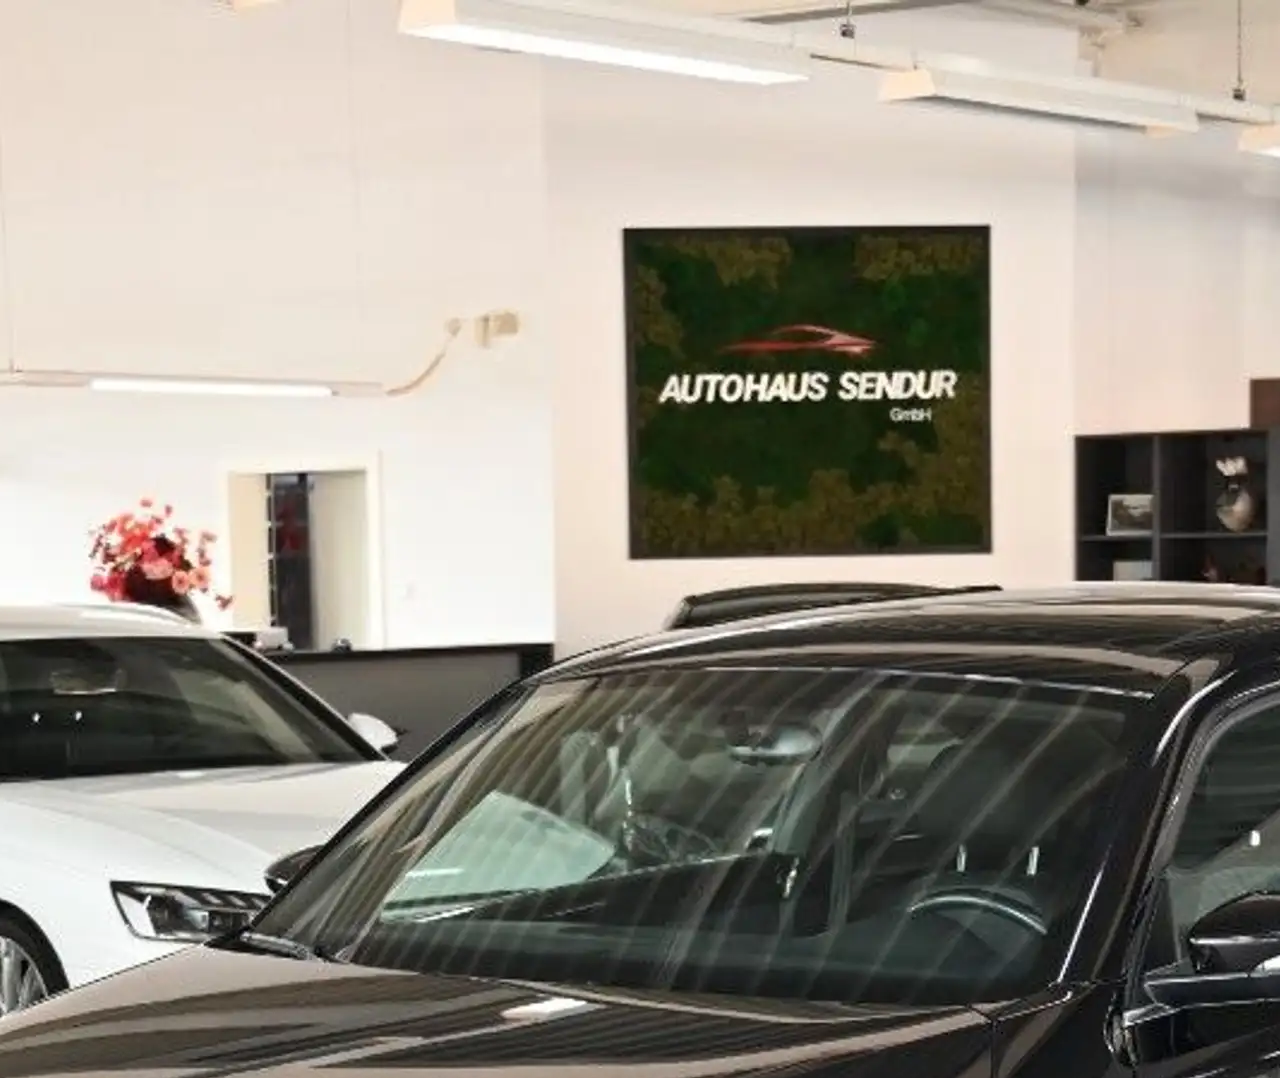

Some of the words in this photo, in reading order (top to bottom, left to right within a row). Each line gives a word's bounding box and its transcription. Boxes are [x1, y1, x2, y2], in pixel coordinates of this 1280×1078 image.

[659, 372, 829, 403] AUTOHAUS
[838, 369, 958, 401] SENDUR
[889, 407, 932, 421] GmbH
